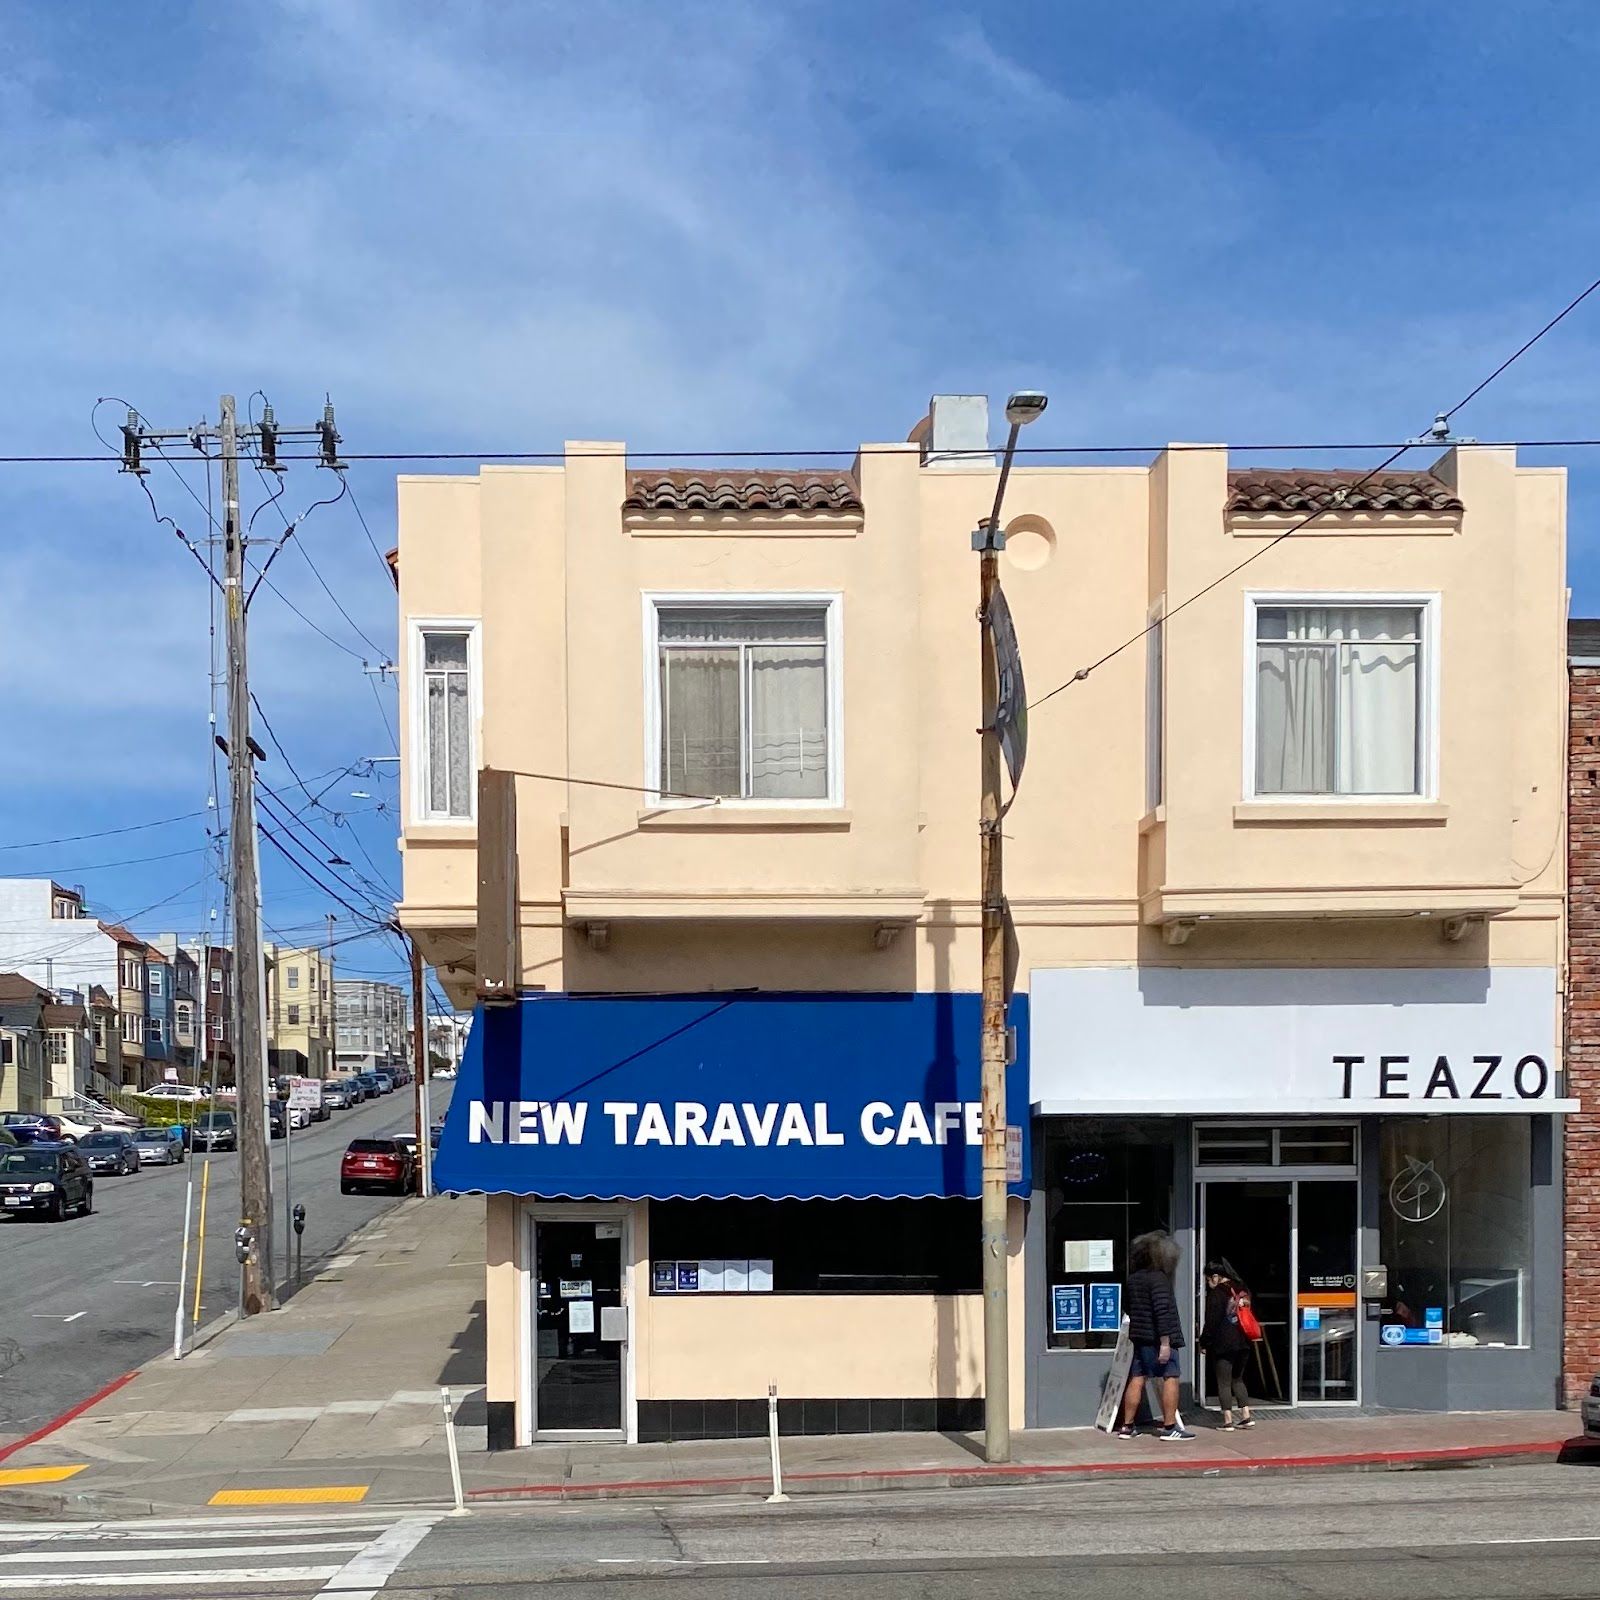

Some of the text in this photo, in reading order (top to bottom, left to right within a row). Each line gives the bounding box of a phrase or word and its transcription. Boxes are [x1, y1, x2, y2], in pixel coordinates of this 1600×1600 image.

[1333, 1055, 1548, 1099] TEAZO
[469, 1101, 984, 1146] NEW TARAVAL CAFE
